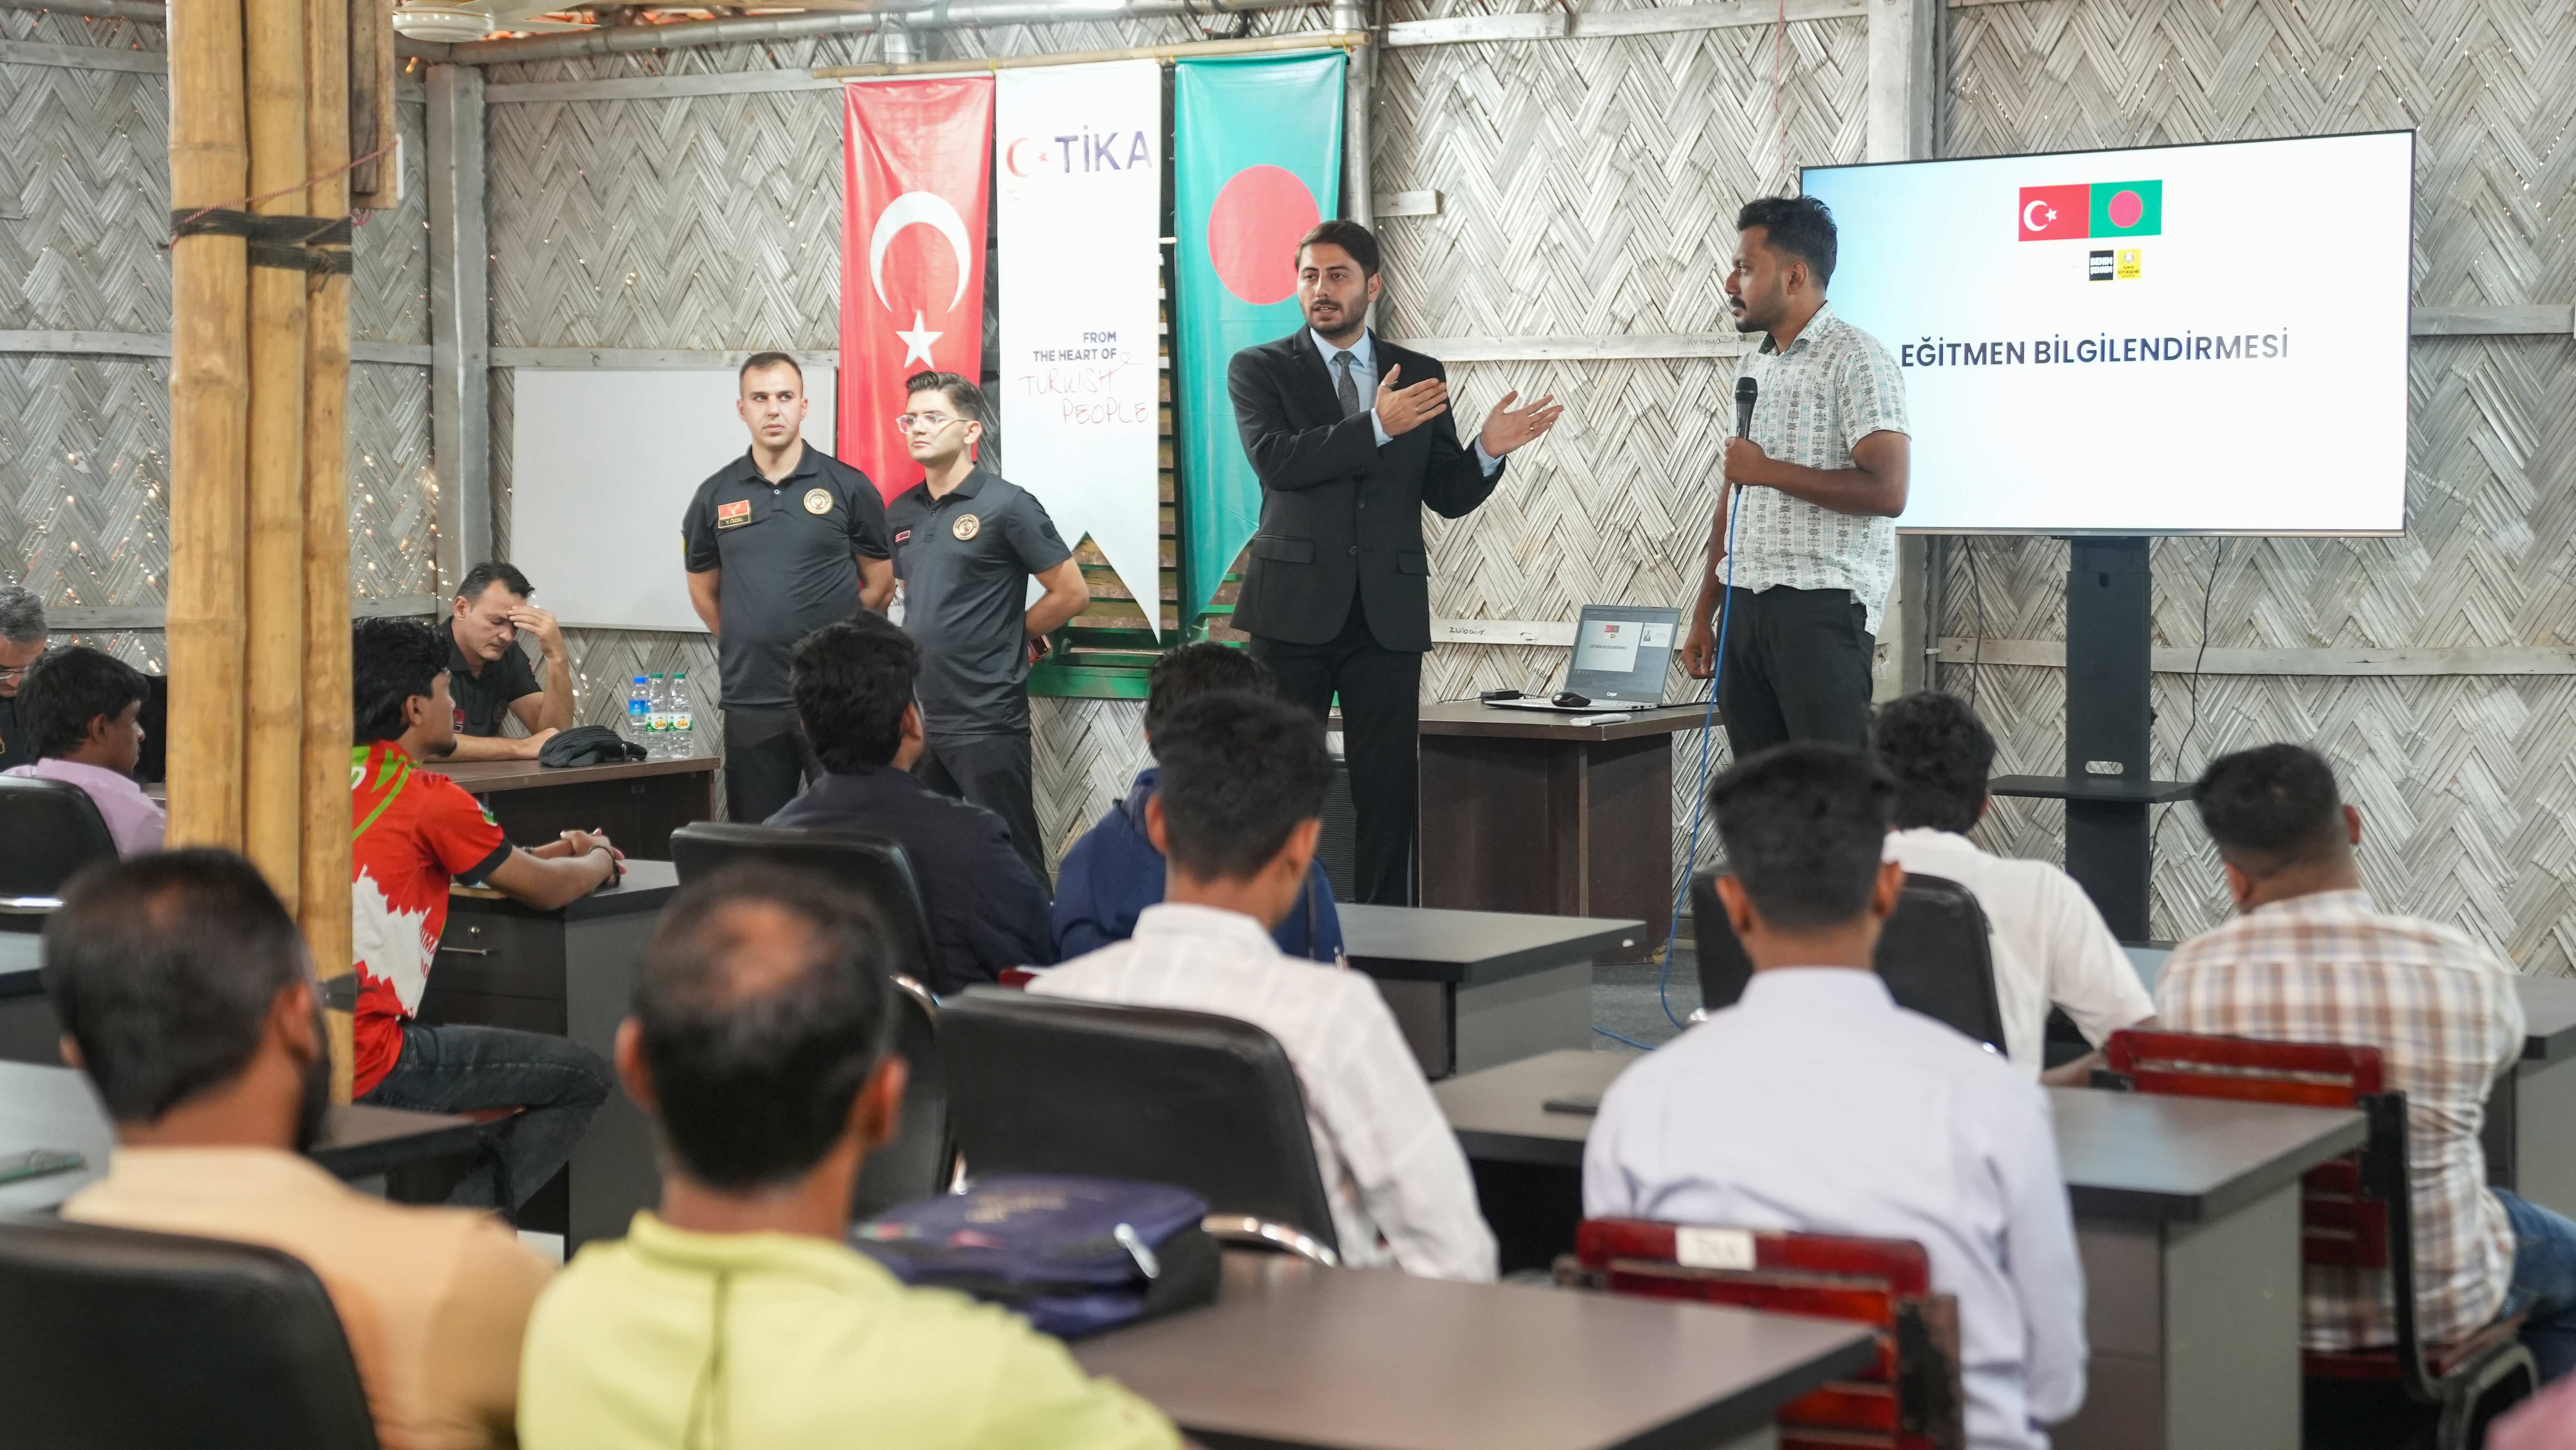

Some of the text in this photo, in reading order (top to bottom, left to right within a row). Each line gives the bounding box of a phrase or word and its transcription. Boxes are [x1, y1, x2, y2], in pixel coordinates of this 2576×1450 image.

[1054, 124, 1153, 173] TİKA
[1083, 331, 1116, 343] FROM
[1902, 327, 2287, 367] EĞİTMEN BİLGİLENDİRMESİ
[1033, 348, 1117, 362] THE HEART OF
[1018, 368, 1112, 395] TURKISH
[1063, 397, 1149, 425] PEOPLE
